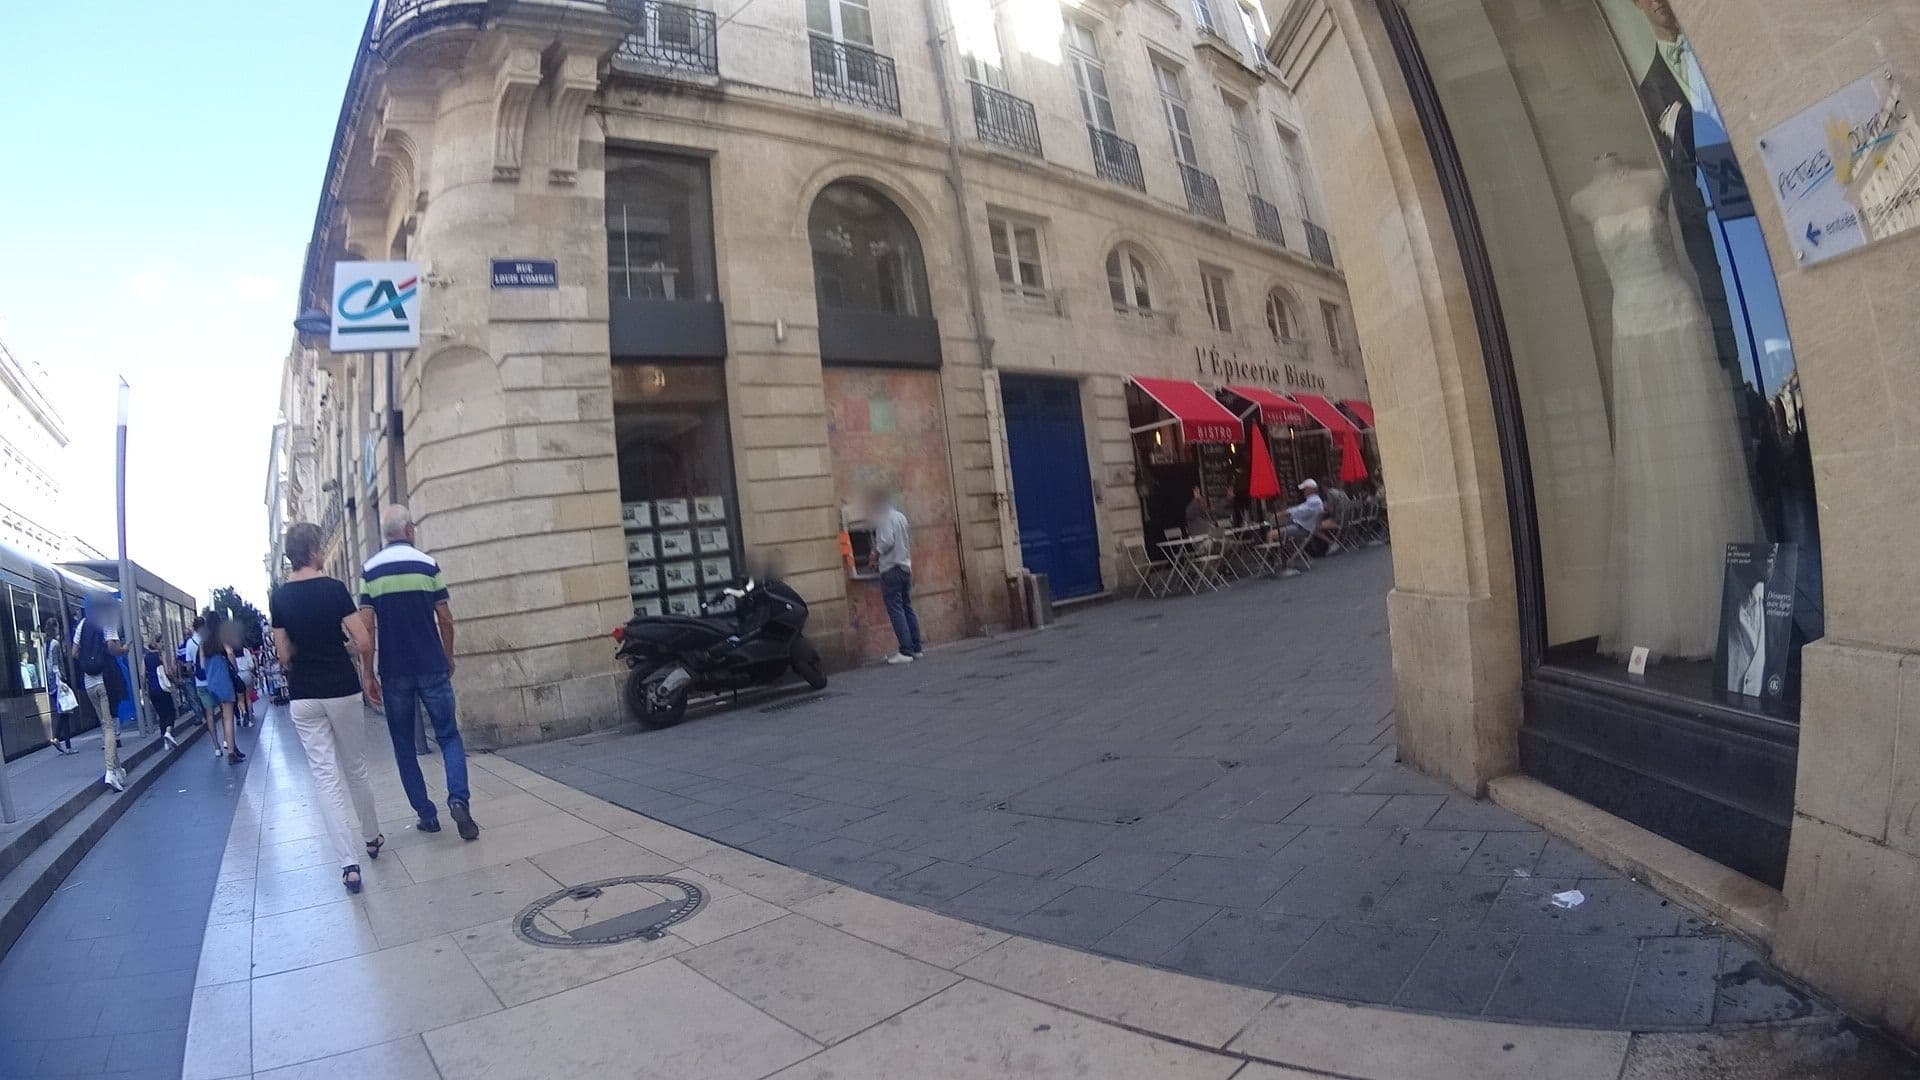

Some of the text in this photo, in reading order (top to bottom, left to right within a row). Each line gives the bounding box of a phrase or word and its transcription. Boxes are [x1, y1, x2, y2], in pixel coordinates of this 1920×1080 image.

[515, 263, 534, 274] RUE
[494, 273, 555, 285] LOUIS COMBES
[338, 276, 417, 321] CA
[1195, 344, 1326, 392] l'Épicerie Bistro
[1197, 425, 1233, 440] BISTRO
